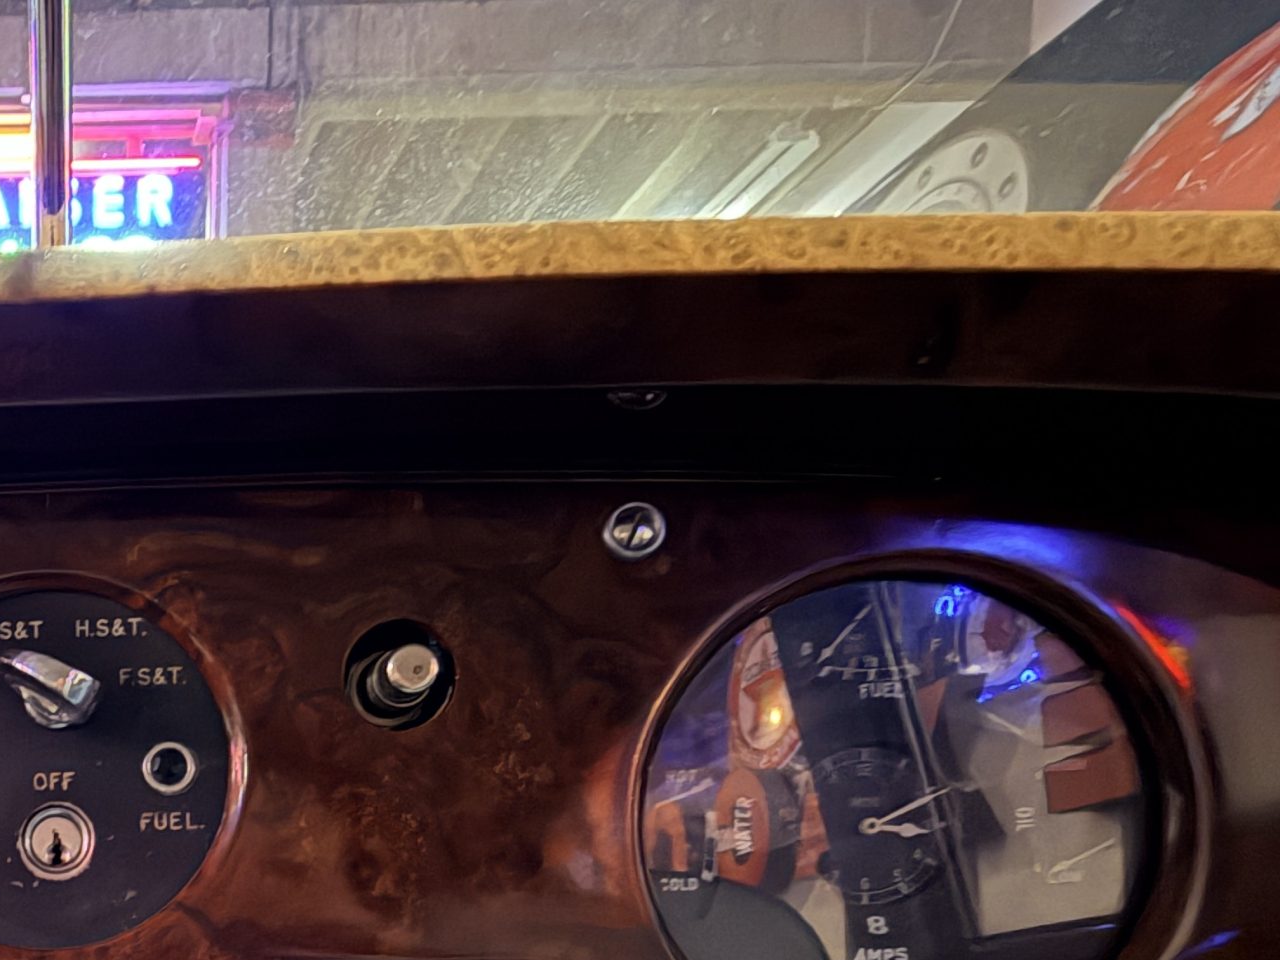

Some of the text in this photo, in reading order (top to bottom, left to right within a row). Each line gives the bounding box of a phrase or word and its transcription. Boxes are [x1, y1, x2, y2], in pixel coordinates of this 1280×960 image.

[75, 617, 149, 638] H.S&T.
[859, 681, 904, 700] FUEL
[33, 771, 76, 791] OFF
[139, 811, 206, 832] FUEL.
[732, 796, 756, 857] WATER
[1014, 806, 1037, 832] OIL
